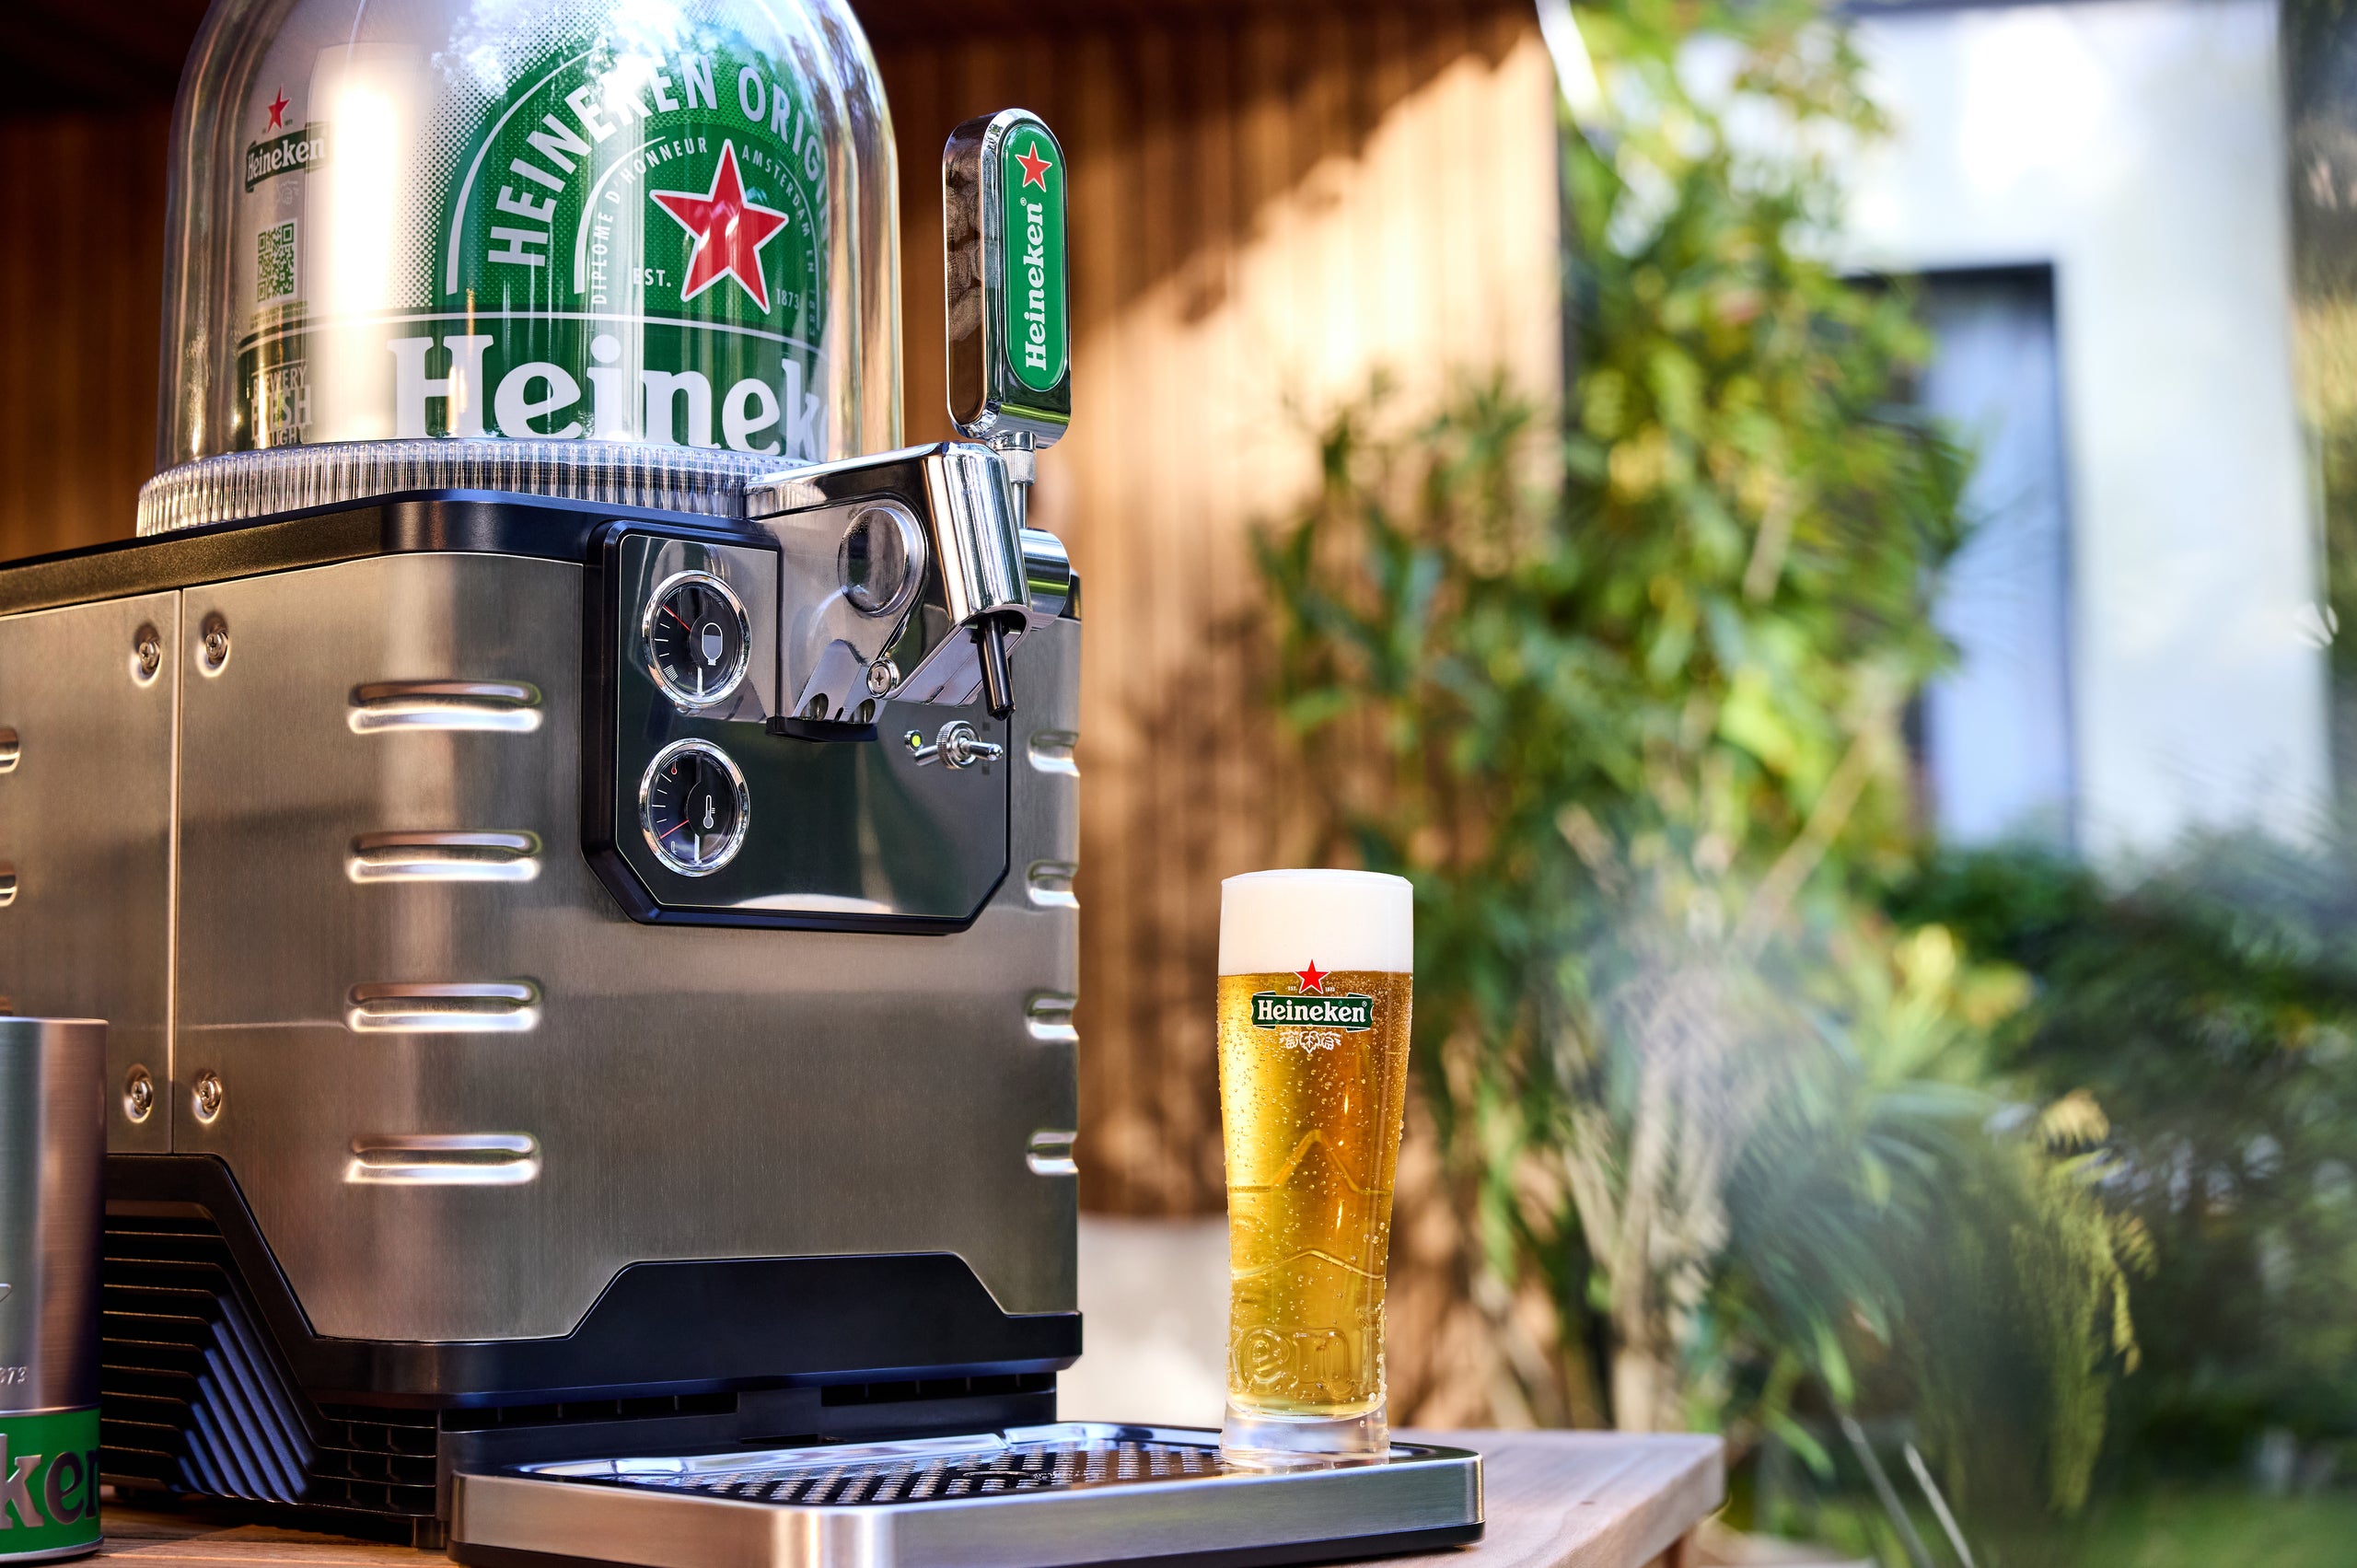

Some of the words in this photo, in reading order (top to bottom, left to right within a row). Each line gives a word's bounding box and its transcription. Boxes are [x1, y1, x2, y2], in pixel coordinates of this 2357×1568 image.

[247, 137, 326, 182] Heineken
[591, 211, 614, 305] DIPLOME
[741, 145, 810, 237] AMSTERDAM
[633, 267, 672, 287] EST.
[776, 287, 800, 310] 1873
